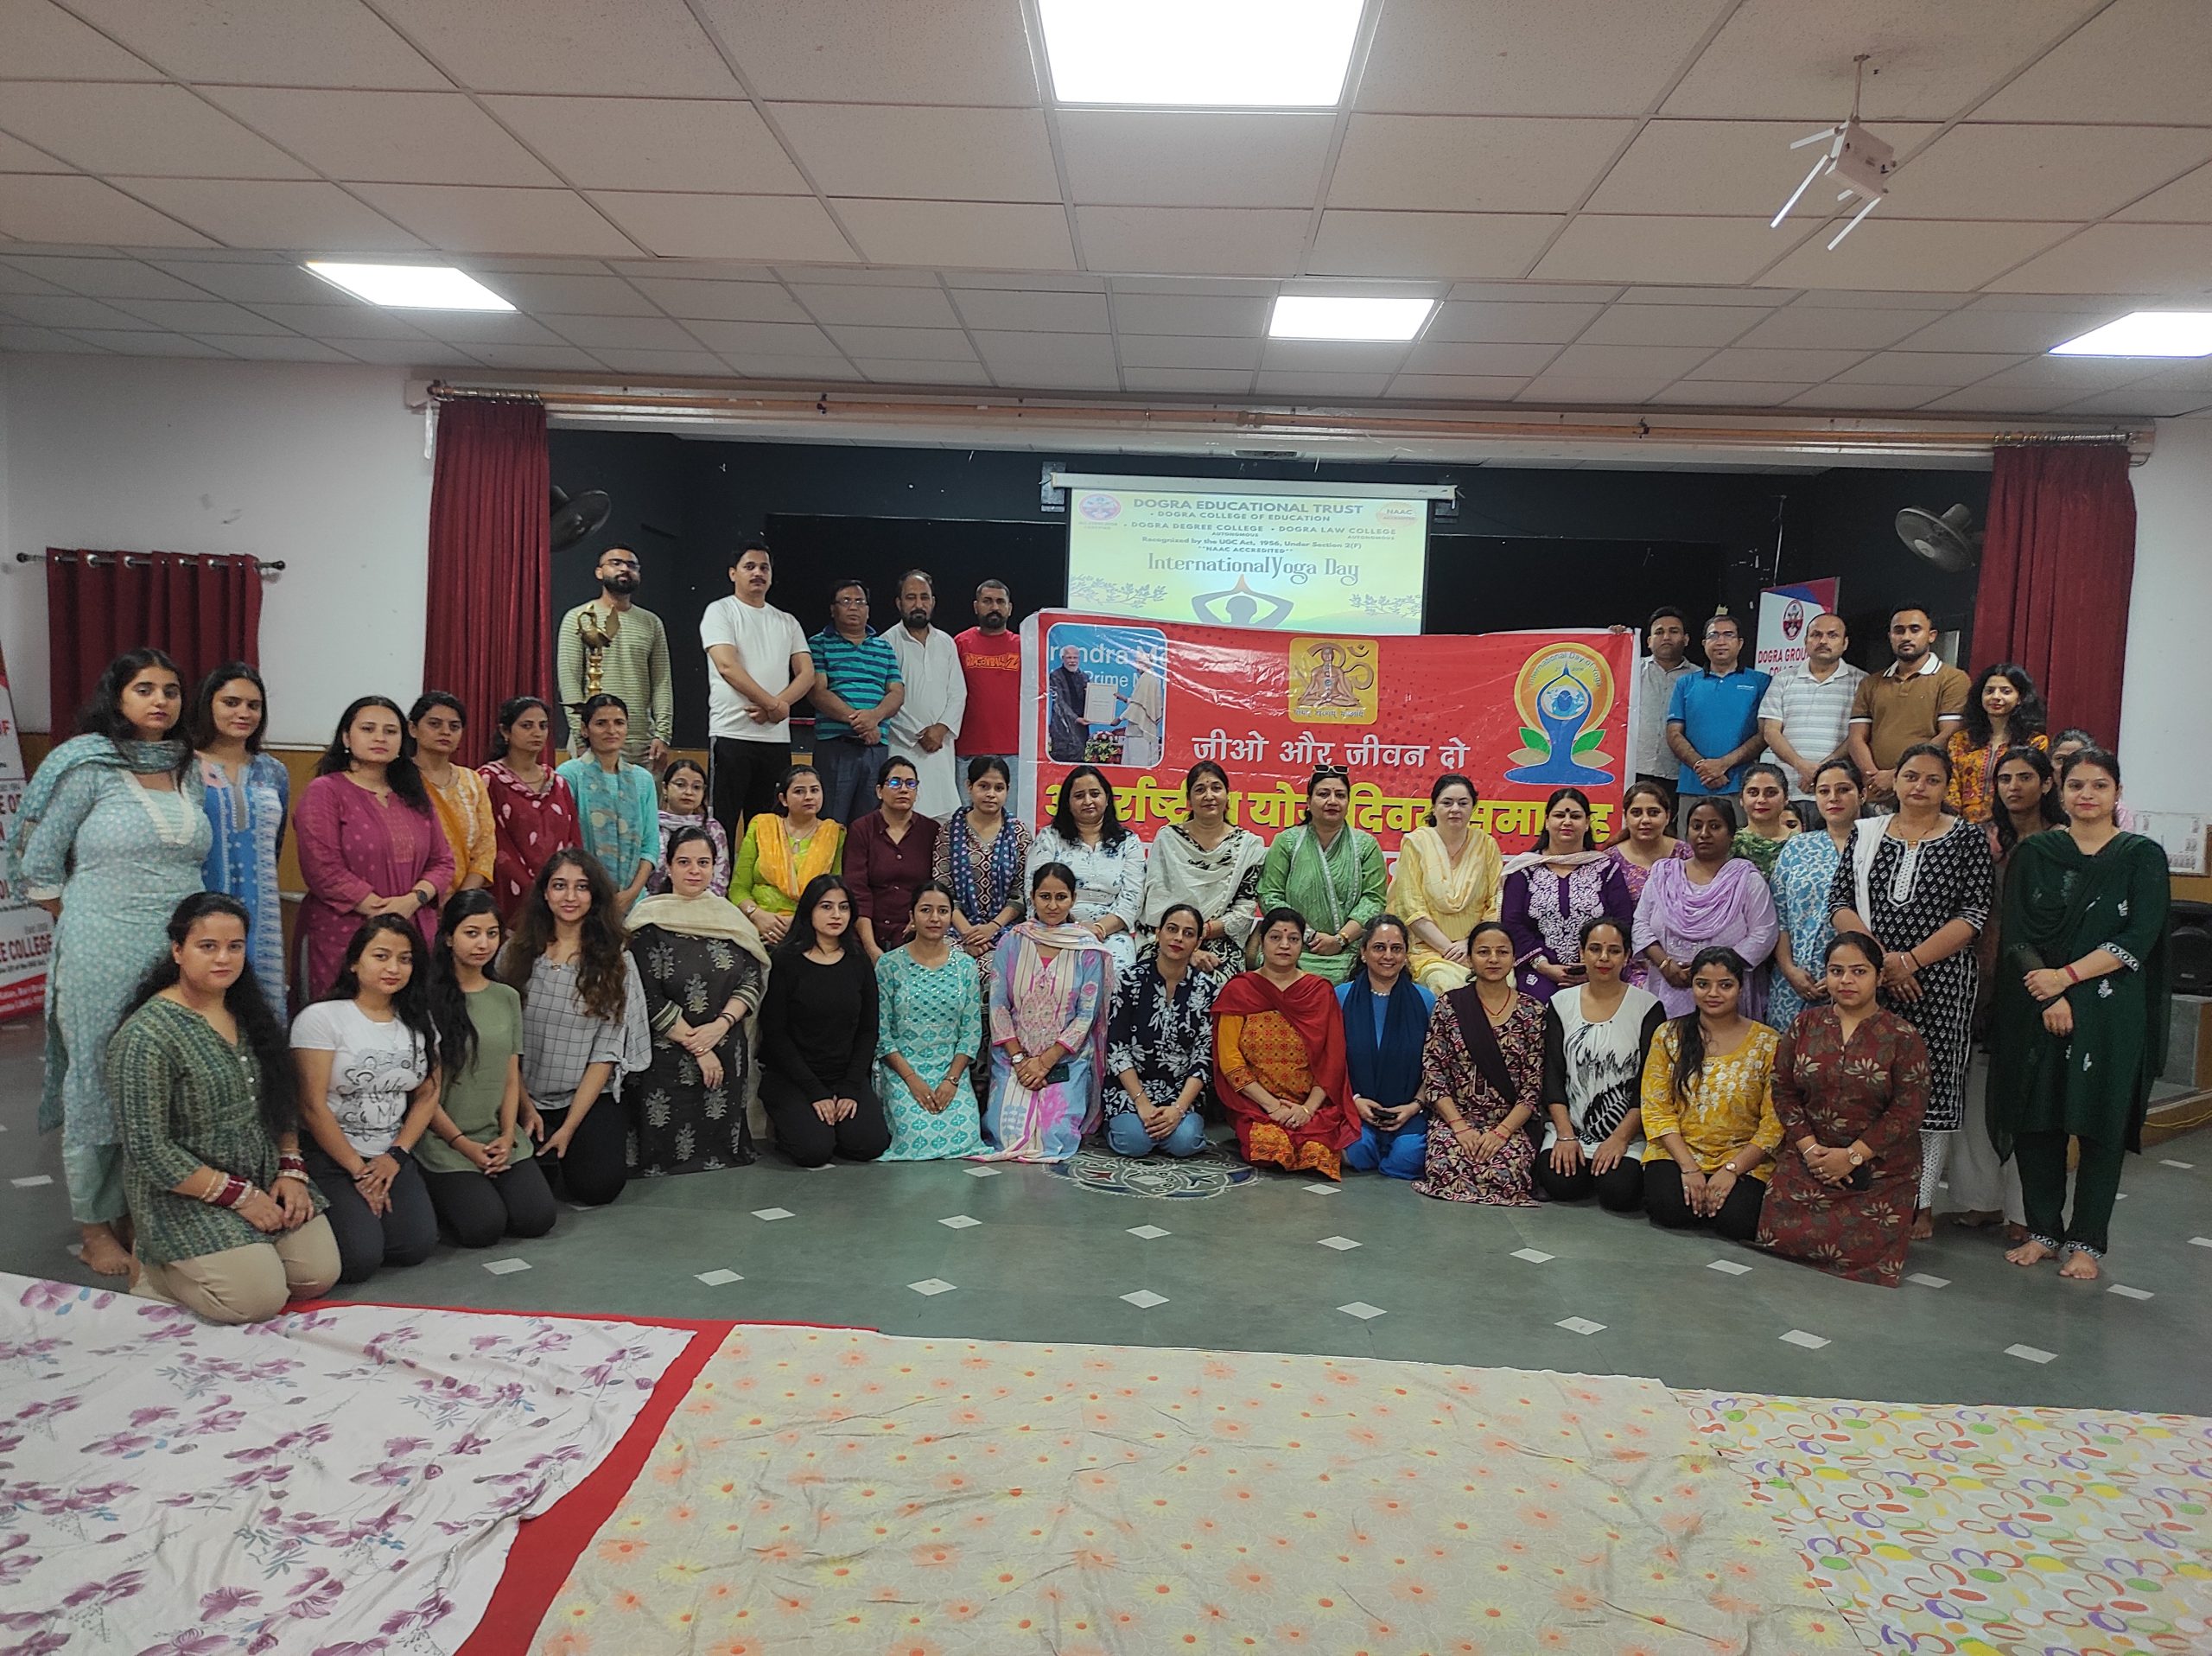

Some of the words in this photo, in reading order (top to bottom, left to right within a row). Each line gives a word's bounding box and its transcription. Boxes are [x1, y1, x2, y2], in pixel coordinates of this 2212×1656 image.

[1133, 498, 1192, 510] DOGRA
[1196, 500, 1309, 513] EDUCATIONAL
[1313, 504, 1363, 514] TRUST
[1216, 524, 1264, 532] COLLEGE
[1325, 557, 1360, 587] Day
[1568, 651, 1584, 663] Day
[1585, 659, 1595, 668] of
[1758, 648, 1783, 664] DOGRA
[1784, 647, 1809, 662] GROU
[1192, 728, 1269, 762] जीओ
[1279, 730, 1336, 767] और
[1344, 734, 1430, 767] जीवन
[1438, 736, 1471, 770] दो
